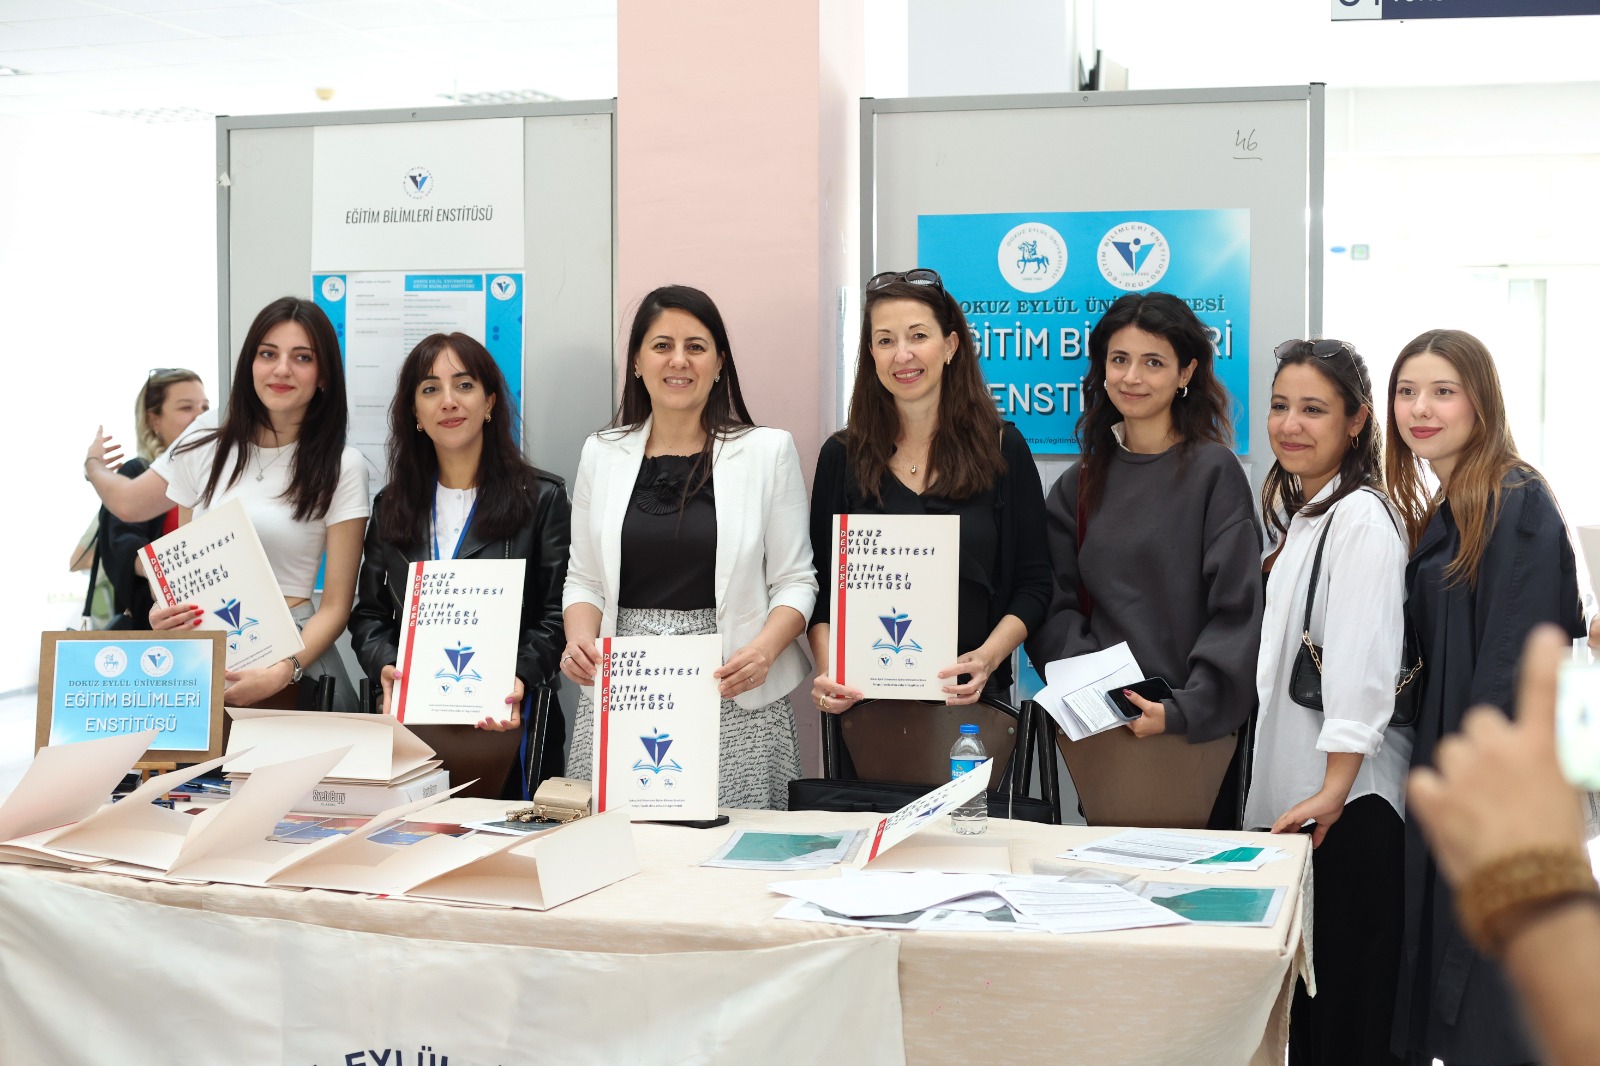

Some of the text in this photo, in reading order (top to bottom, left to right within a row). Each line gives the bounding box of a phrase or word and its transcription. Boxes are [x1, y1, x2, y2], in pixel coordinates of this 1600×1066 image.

[1235, 128, 1258, 151] 46
[345, 204, 493, 224] EĞİTİM BİLİMLERİ ENSTİTÜSÜ
[961, 300, 1010, 314] OKUZ
[1017, 296, 1078, 314] EYLÜL
[967, 321, 1049, 359] ĞİTİM
[987, 376, 1085, 414] ENSTİ
[68, 677, 197, 687] DOKUZ EYLÜL ÜNİVERSİTESİ
[64, 689, 201, 708] EĞİTİM BİLİMLERİ
[85, 714, 177, 733] ENSTİTÜSÜ
